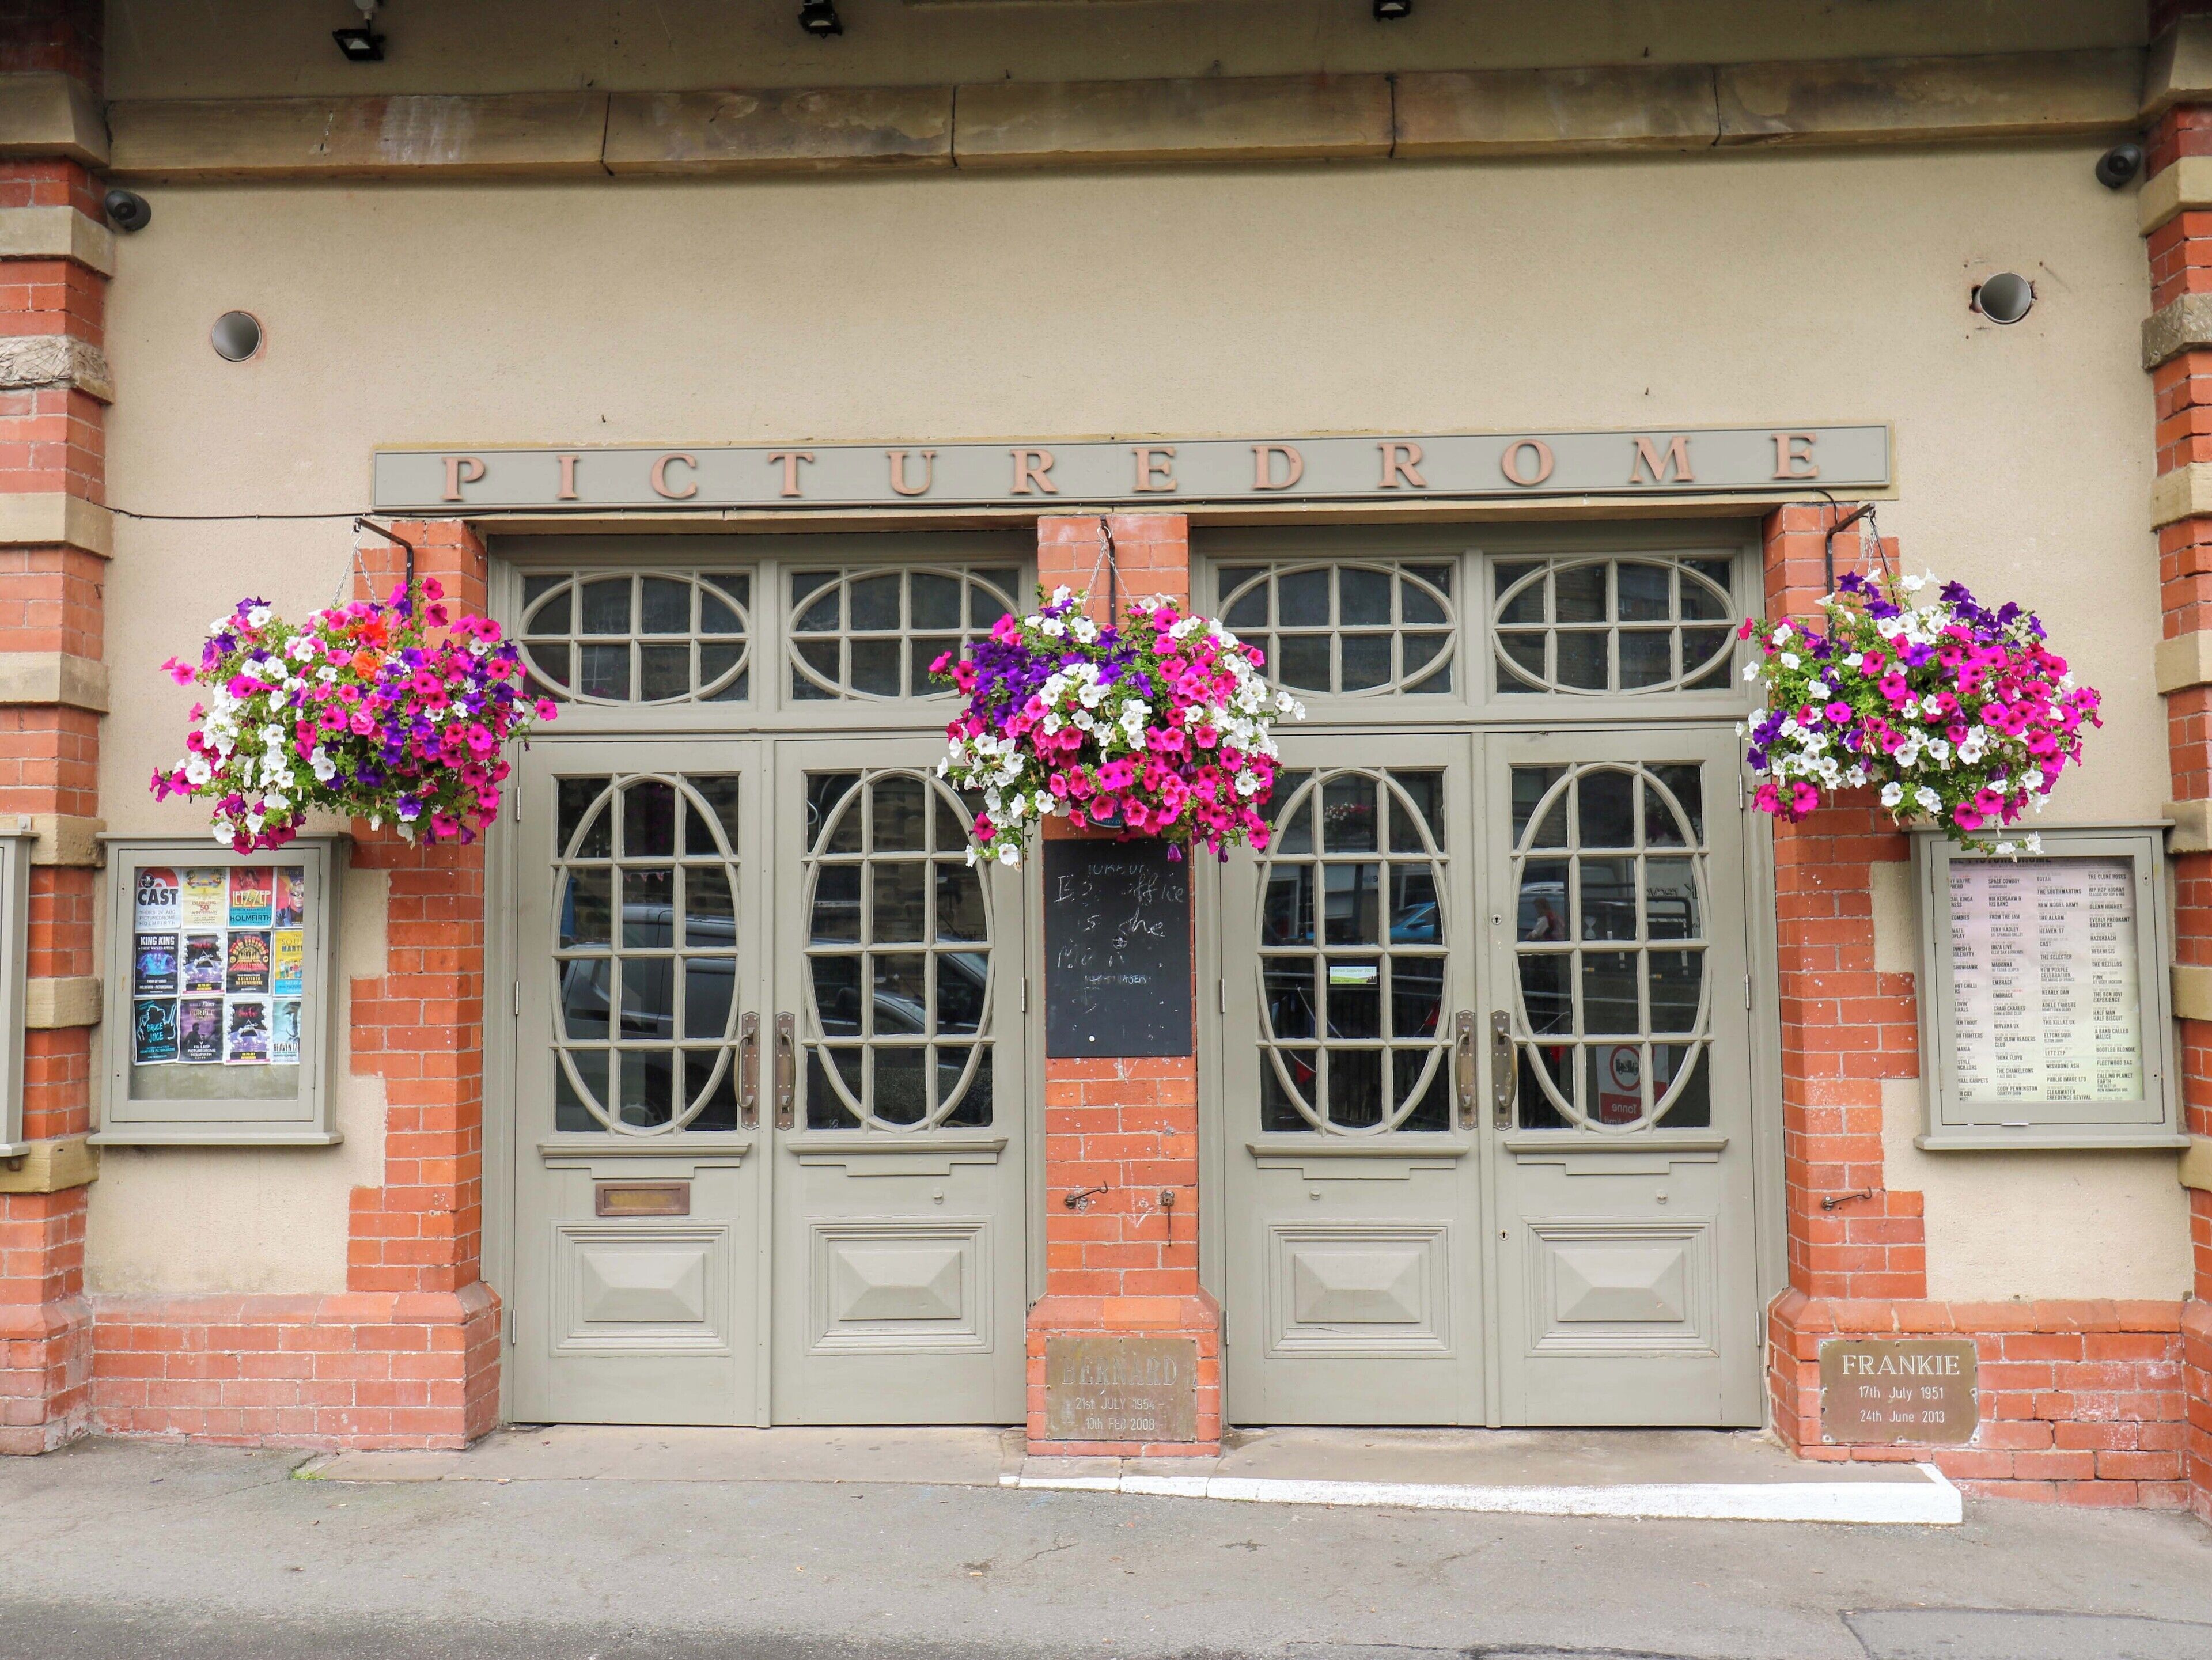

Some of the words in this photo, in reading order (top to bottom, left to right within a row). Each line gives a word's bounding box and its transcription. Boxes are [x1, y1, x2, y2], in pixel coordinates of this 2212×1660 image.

[441, 432, 1820, 501] PICTUREDROME
[138, 889, 178, 905] CAST
[141, 937, 157, 945] KING
[158, 936, 175, 945] KING
[147, 1022, 163, 1032] BRUCE
[1062, 1356, 1177, 1385] BERNARD
[1842, 1355, 1960, 1375] FRANKIE
[1859, 1386, 1880, 1399] 17th
[1889, 1387, 1912, 1402] July
[1921, 1387, 1944, 1399] 1951
[1075, 1398, 1094, 1409] 21st
[1101, 1399, 1126, 1410] JULY
[1132, 1399, 1154, 1410] 1954
[1108, 1418, 1126, 1430] FEB
[1130, 1418, 1155, 1430] 2008
[1861, 1411, 1881, 1422] 24th
[1889, 1411, 1914, 1423] June
[1922, 1411, 1945, 1423] 2013
